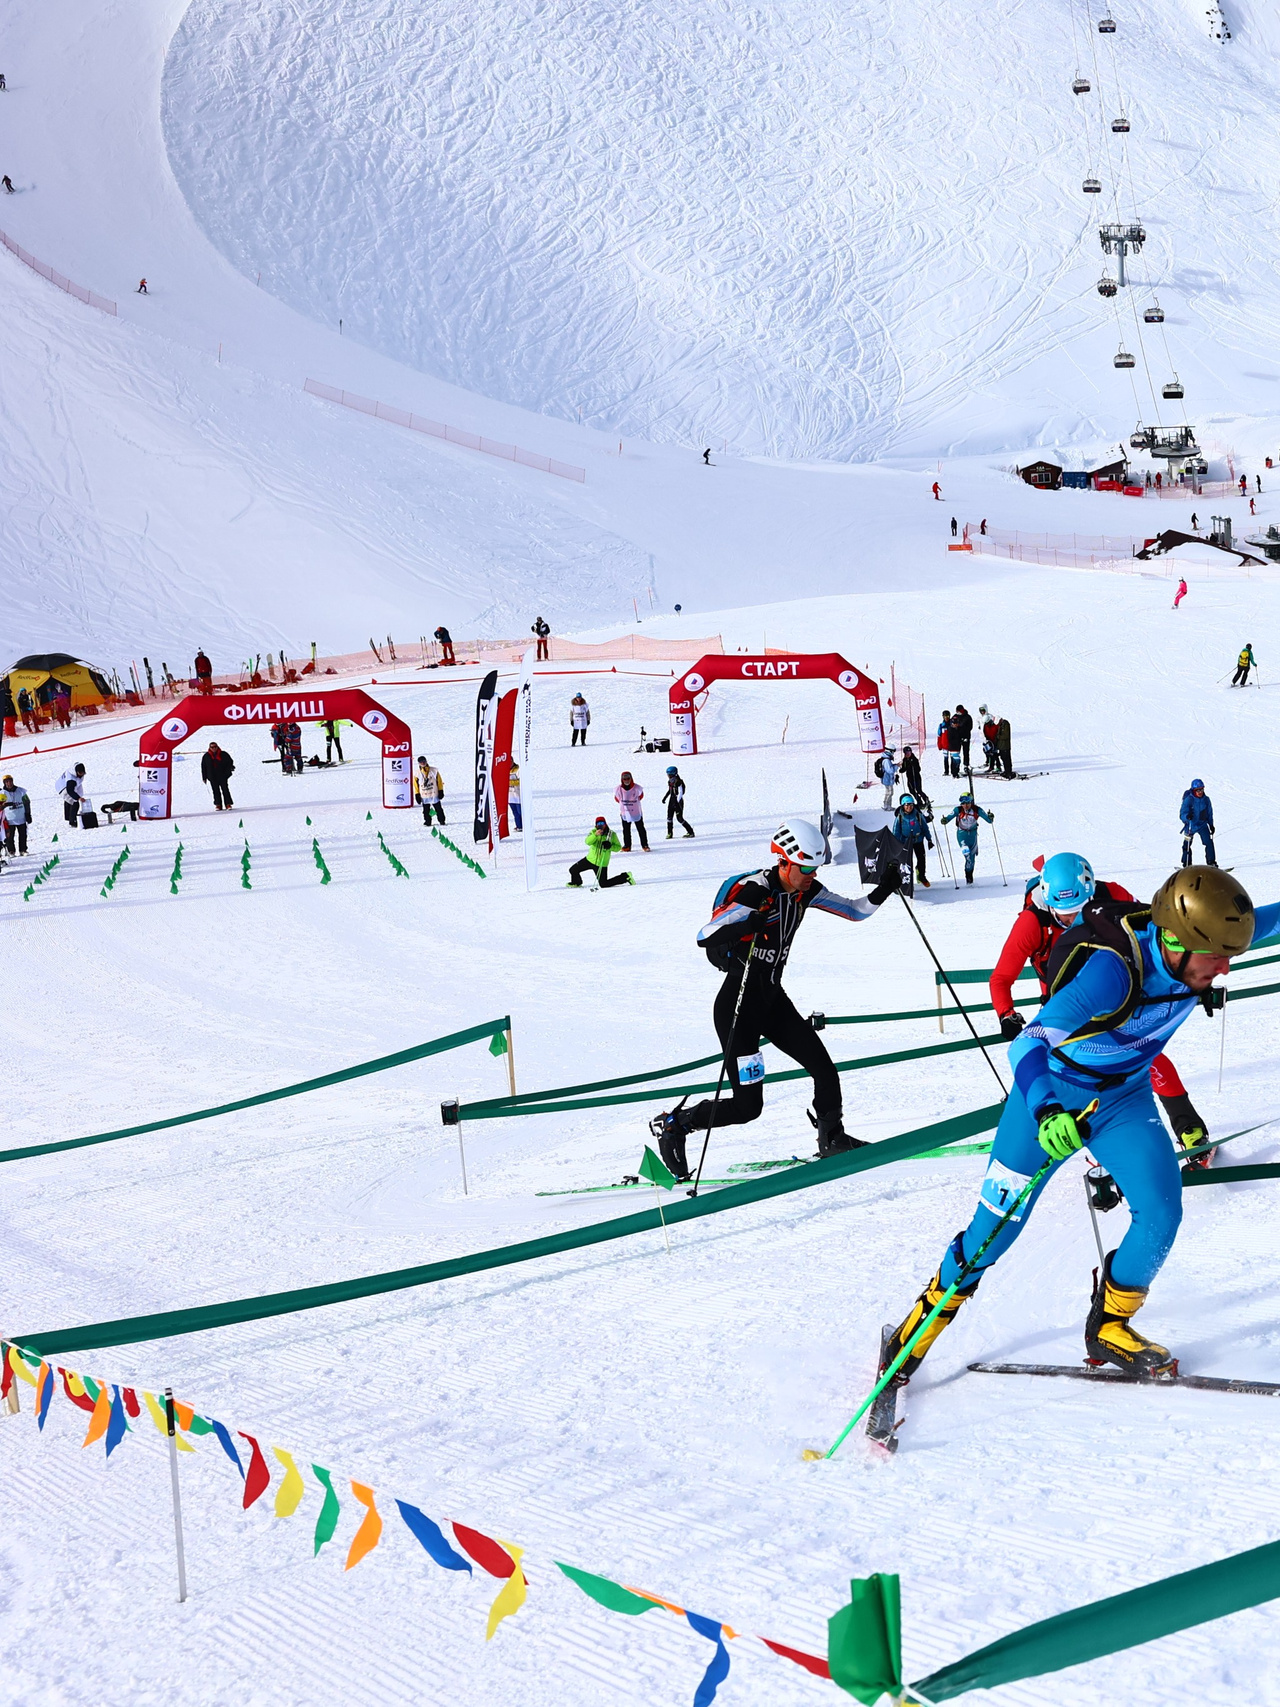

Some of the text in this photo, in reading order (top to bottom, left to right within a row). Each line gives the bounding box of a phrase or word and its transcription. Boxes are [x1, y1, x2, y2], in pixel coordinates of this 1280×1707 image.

[741, 661, 800, 677] СТАРТ
[223, 699, 325, 721] ФИНИШ
[745, 1065, 760, 1078] 15
[999, 1187, 1009, 1207] 1
